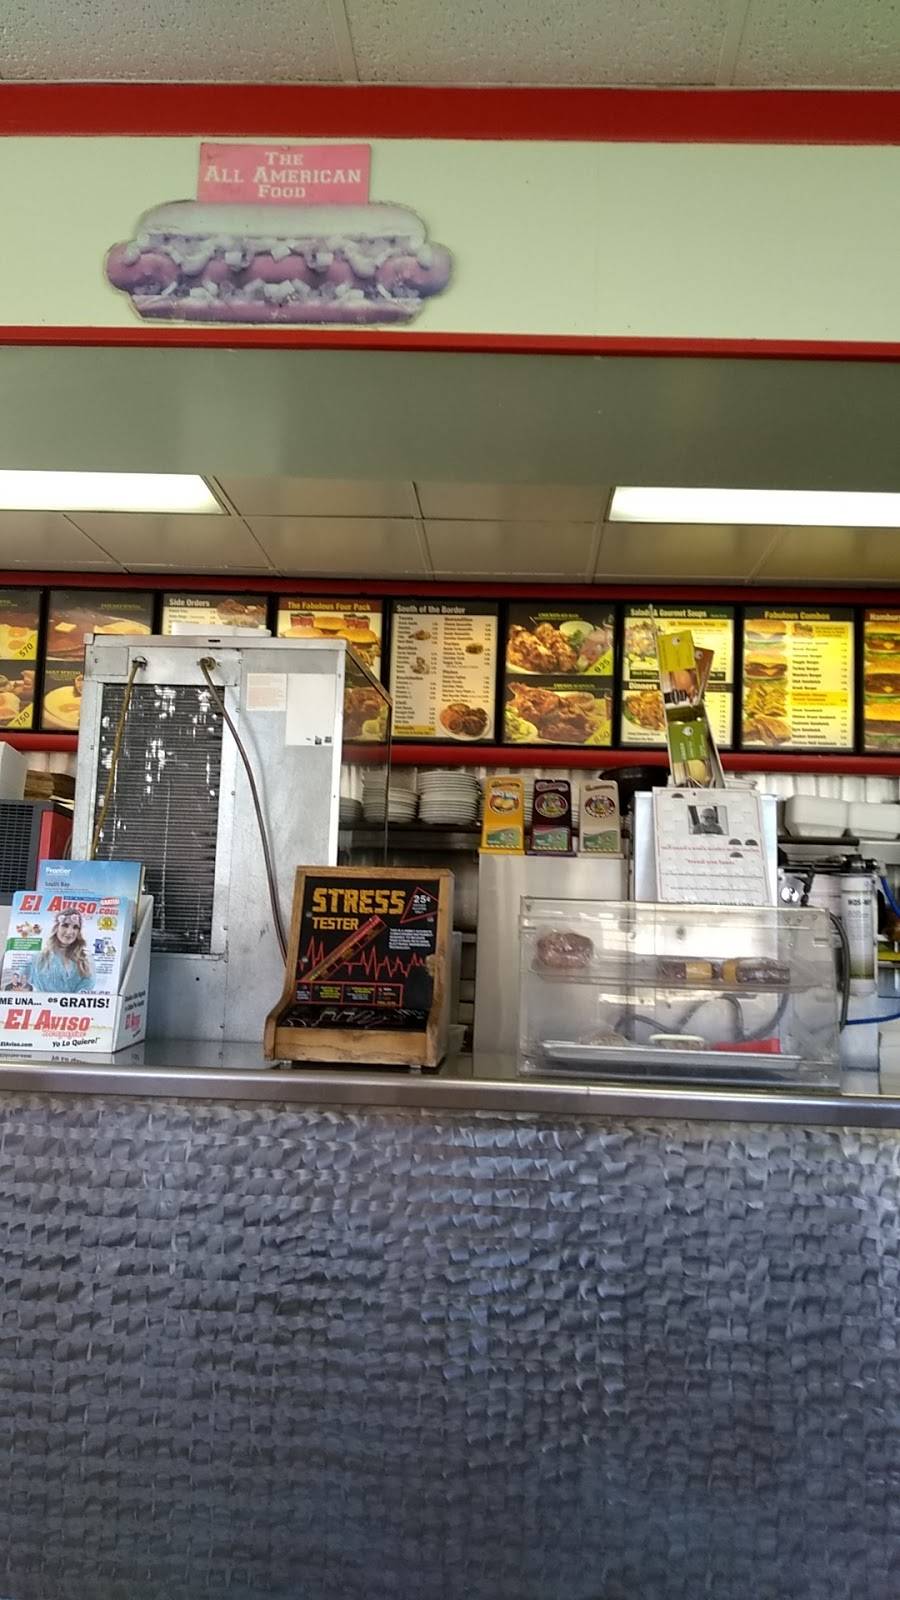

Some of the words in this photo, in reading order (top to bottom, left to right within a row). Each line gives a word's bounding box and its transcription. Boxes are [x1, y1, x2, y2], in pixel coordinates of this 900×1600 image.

[204, 165, 244, 182] ALL
[253, 166, 361, 184] AMERICAN
[257, 184, 306, 198] FOOD
[169, 598, 185, 606] Side
[186, 599, 210, 608] Orders
[288, 601, 300, 609] The
[301, 602, 334, 610] Fabulous
[353, 603, 371, 611] Pack
[396, 604, 418, 613] South
[419, 605, 427, 613] of
[428, 605, 440, 613] the
[441, 605, 465, 614] Border
[659, 608, 687, 617] Gourmet
[687, 608, 708, 618] Soups
[764, 610, 799, 620] Fabulous
[799, 611, 830, 620] Combos
[628, 682, 657, 690] Dinners
[19, 895, 43, 911] El
[312, 887, 406, 915] STRESS
[311, 916, 359, 930] TESTER
[60, 997, 110, 1008] GRATIS!
[4, 1009, 32, 1030] El
